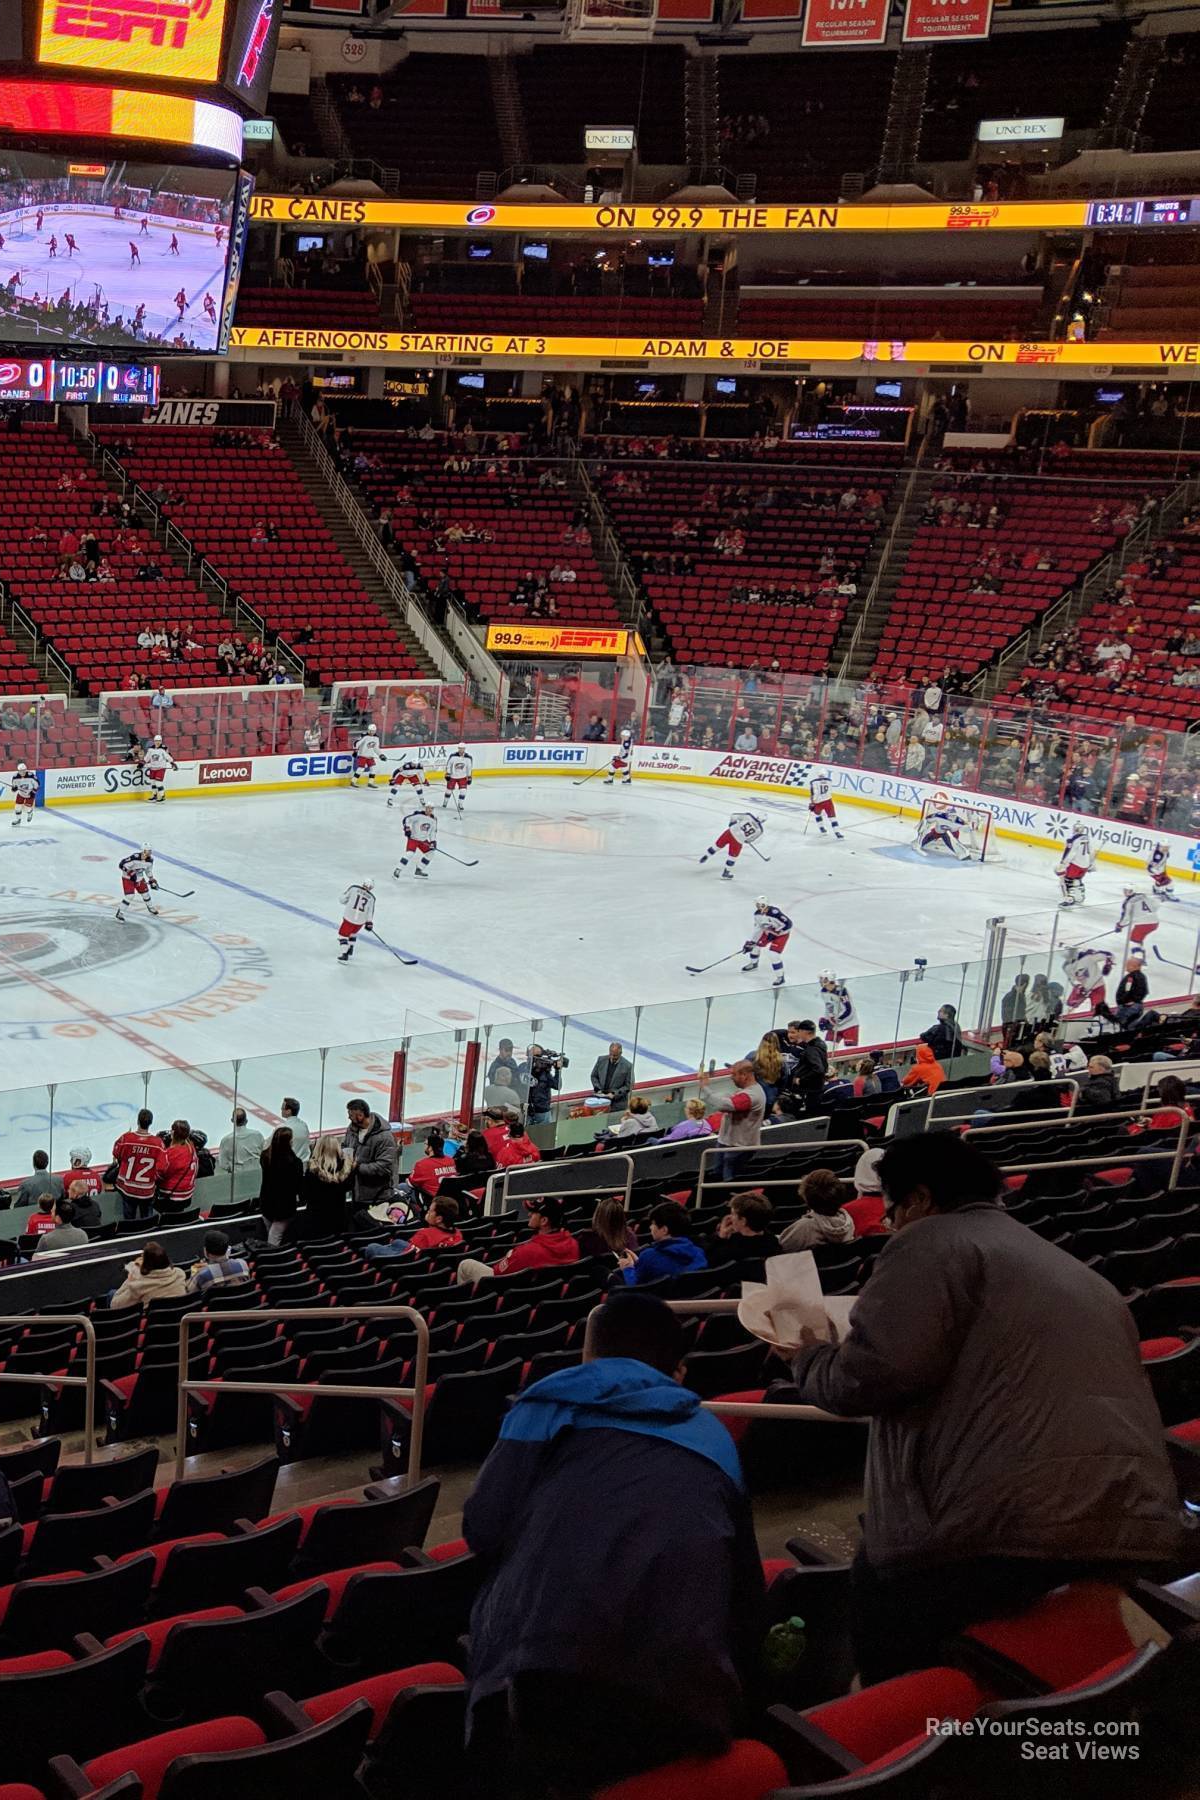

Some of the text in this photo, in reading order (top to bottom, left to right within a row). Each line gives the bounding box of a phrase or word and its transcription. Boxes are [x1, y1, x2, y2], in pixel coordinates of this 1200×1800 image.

[344, 43, 363, 55] 328
[253, 125, 271, 135] REX
[587, 134, 632, 144] UNC REX
[996, 125, 1047, 136] UNC REX
[288, 199, 366, 223] CANES
[1097, 204, 1122, 224] 6:34
[1154, 202, 1180, 211] SHOTS
[596, 206, 839, 230] ON 99.9 THE FAN
[257, 330, 389, 351] AFTERNOONS
[400, 334, 493, 353] STARTING
[505, 337, 531, 353] AT
[536, 338, 547, 354] 3
[642, 340, 789, 358] ADAM & JOE
[968, 344, 1006, 361] ON
[29, 363, 44, 387] 0
[59, 366, 96, 388] 10:56
[107, 366, 118, 390] 0
[66, 392, 87, 400] FIRST
[143, 403, 219, 425] CANES
[494, 632, 522, 645] 99.9
[559, 631, 618, 648] ESPN
[418, 745, 447, 759] DNA
[505, 748, 585, 762] BUD LIGHT
[288, 755, 357, 777] GEIC
[718, 755, 787, 773] Advance
[57, 774, 96, 783] ANALYTICS
[203, 767, 247, 780] Lenovo
[709, 766, 783, 786] Auto Parts
[826, 769, 925, 806] UNC REX
[353, 894, 368, 912] 13
[128, 946, 274, 1029] PNC ARENA
[11, 1101, 138, 1133] UNC
[132, 1145, 150, 1155] STAAL
[125, 1156, 155, 1182] 12
